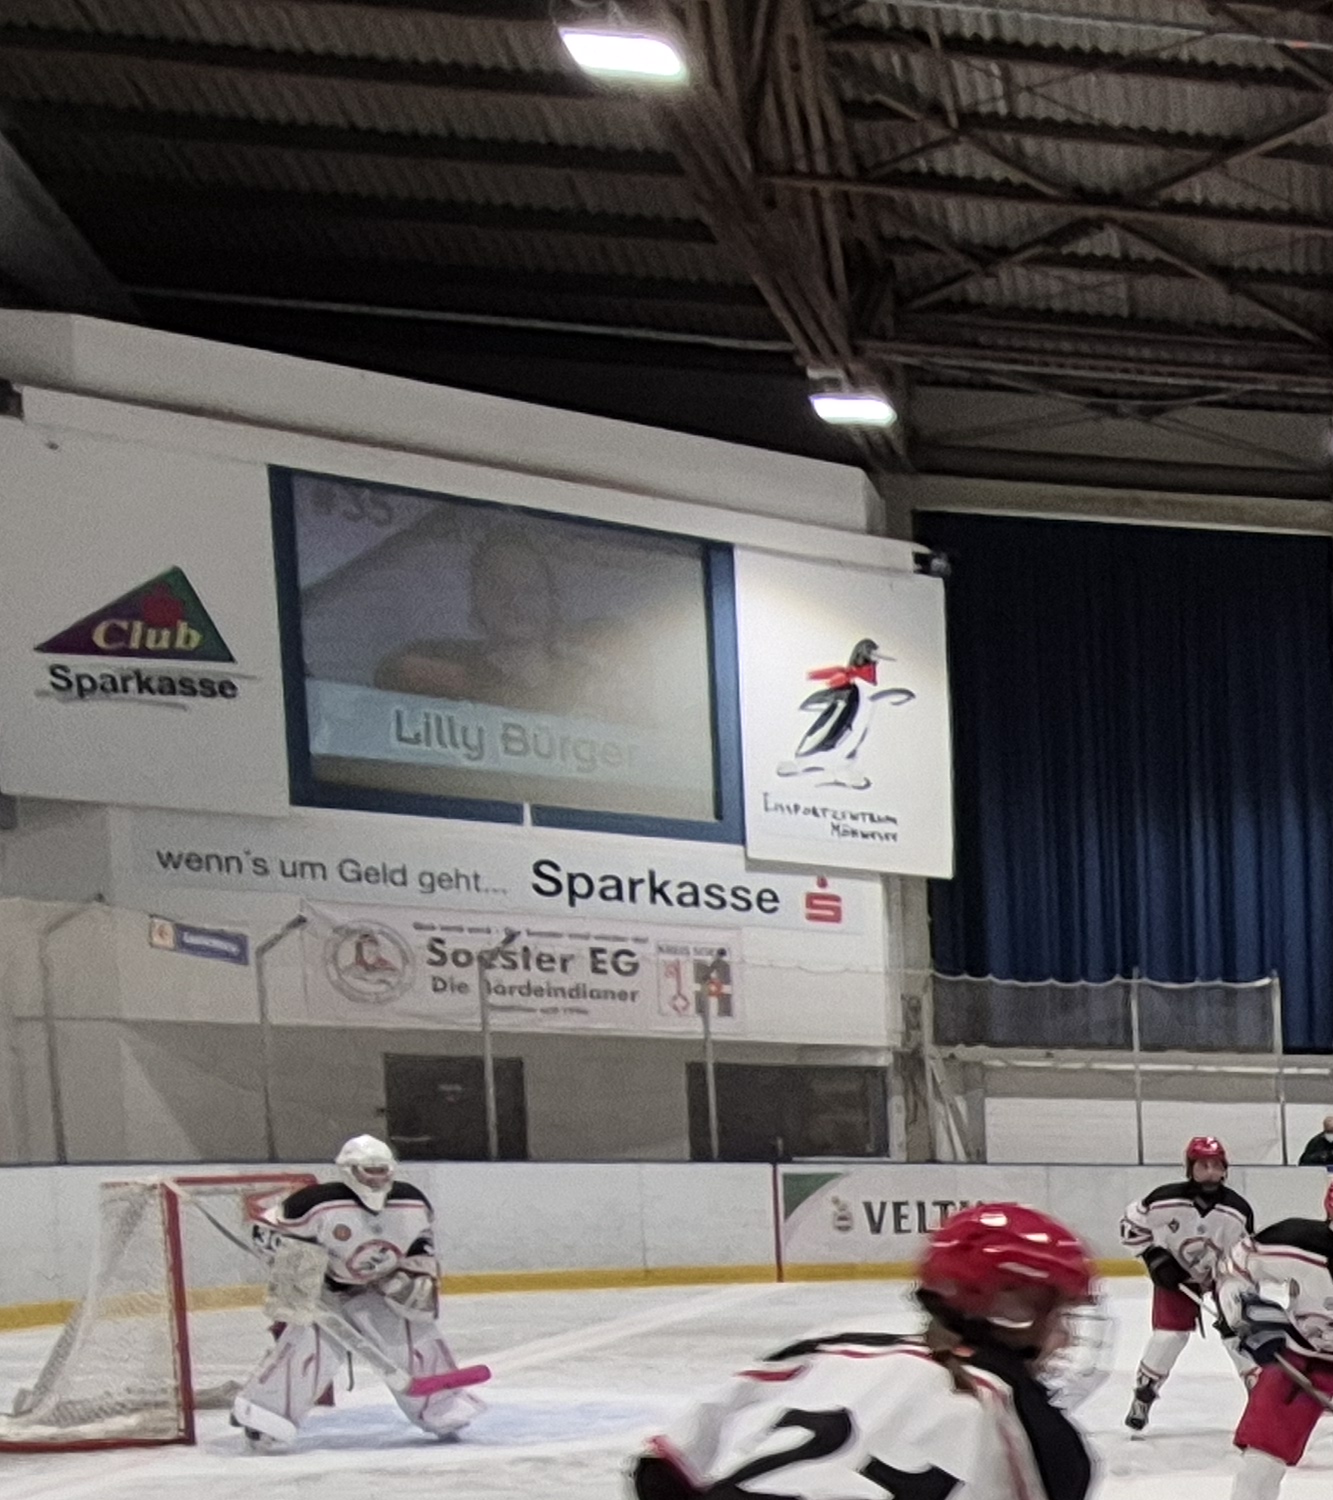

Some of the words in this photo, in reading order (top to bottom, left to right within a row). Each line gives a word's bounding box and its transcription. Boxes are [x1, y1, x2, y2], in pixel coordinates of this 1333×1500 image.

[92, 619, 203, 653] Club
[49, 664, 238, 699] Sparkasse
[395, 708, 485, 762] Lilly
[156, 849, 270, 876] wenn's
[280, 860, 327, 882] um
[338, 859, 408, 888] Geld
[532, 859, 781, 914] Sparkasse
[589, 946, 640, 978] EG
[431, 975, 469, 995] Die
